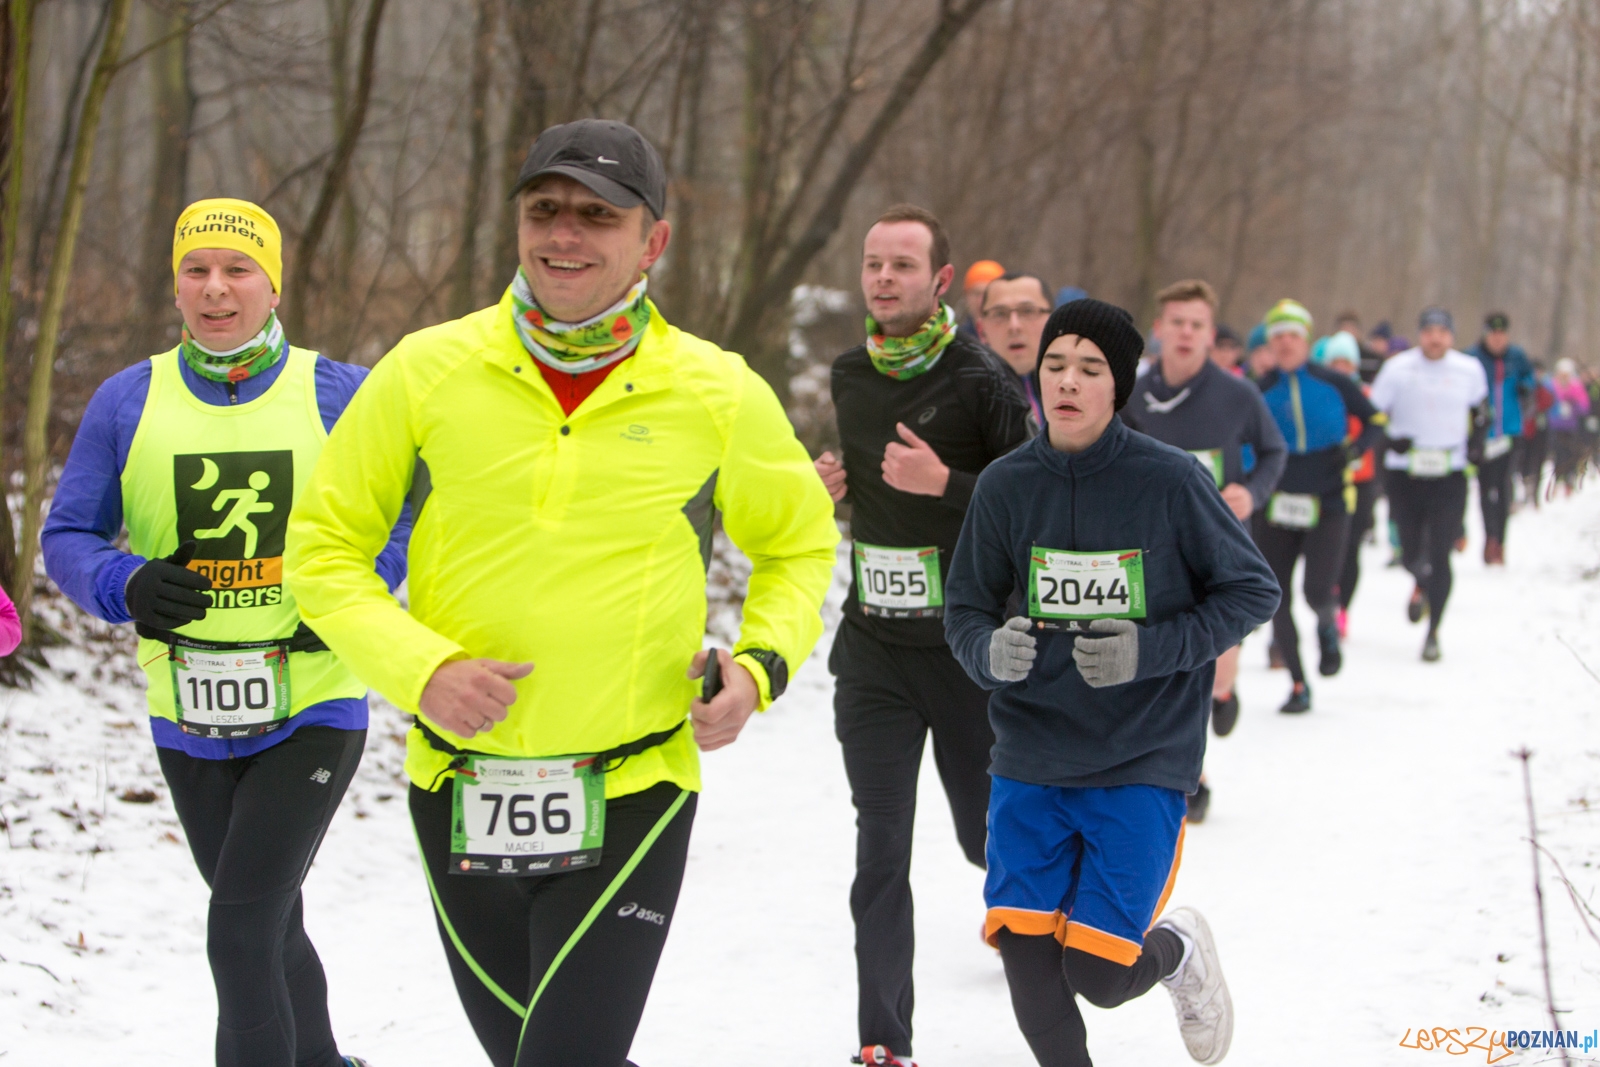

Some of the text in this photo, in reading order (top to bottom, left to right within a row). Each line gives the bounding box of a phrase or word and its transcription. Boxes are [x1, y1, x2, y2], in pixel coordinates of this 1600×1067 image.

[206, 212, 255, 229] night
[188, 223, 264, 248] runners
[196, 560, 264, 588] night
[865, 567, 926, 596] 1055
[1040, 576, 1129, 606] 2044
[186, 677, 269, 711] 1100
[210, 714, 245, 724] LESZEK
[480, 792, 571, 836] 766
[505, 841, 545, 853] MACIEJ
[636, 908, 665, 925] asics
